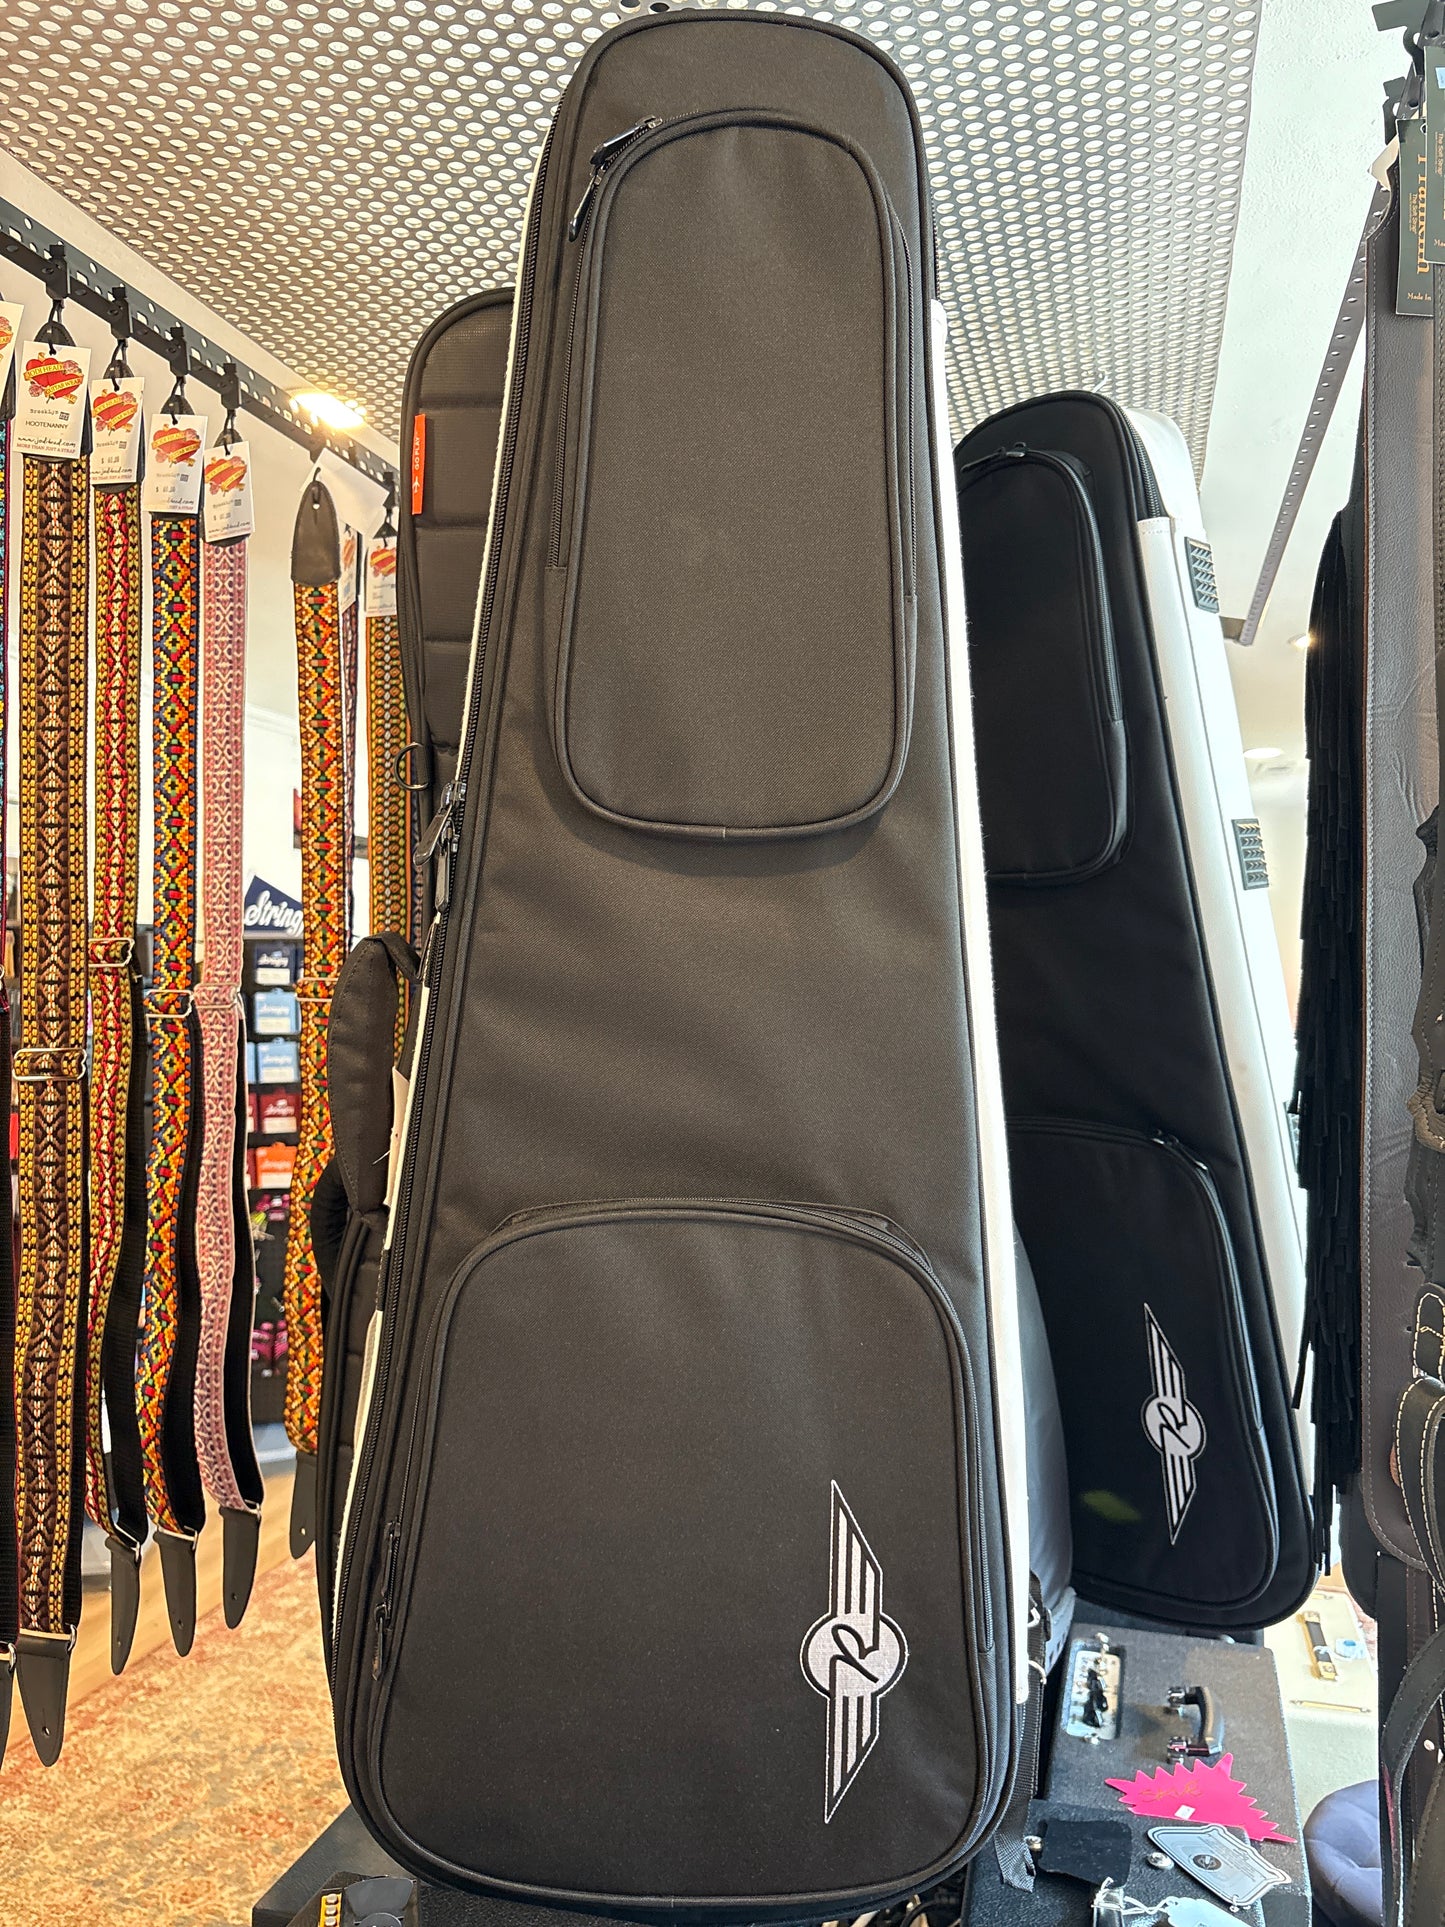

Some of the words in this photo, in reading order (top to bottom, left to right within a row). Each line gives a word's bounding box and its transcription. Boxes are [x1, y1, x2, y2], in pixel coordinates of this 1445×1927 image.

[1407, 292, 1423, 300] Made
[1424, 293, 1432, 301] In
[43, 364, 63, 373] HEAD
[25, 420, 69, 430] HOOTENANNY
[414, 456, 420, 470] GO
